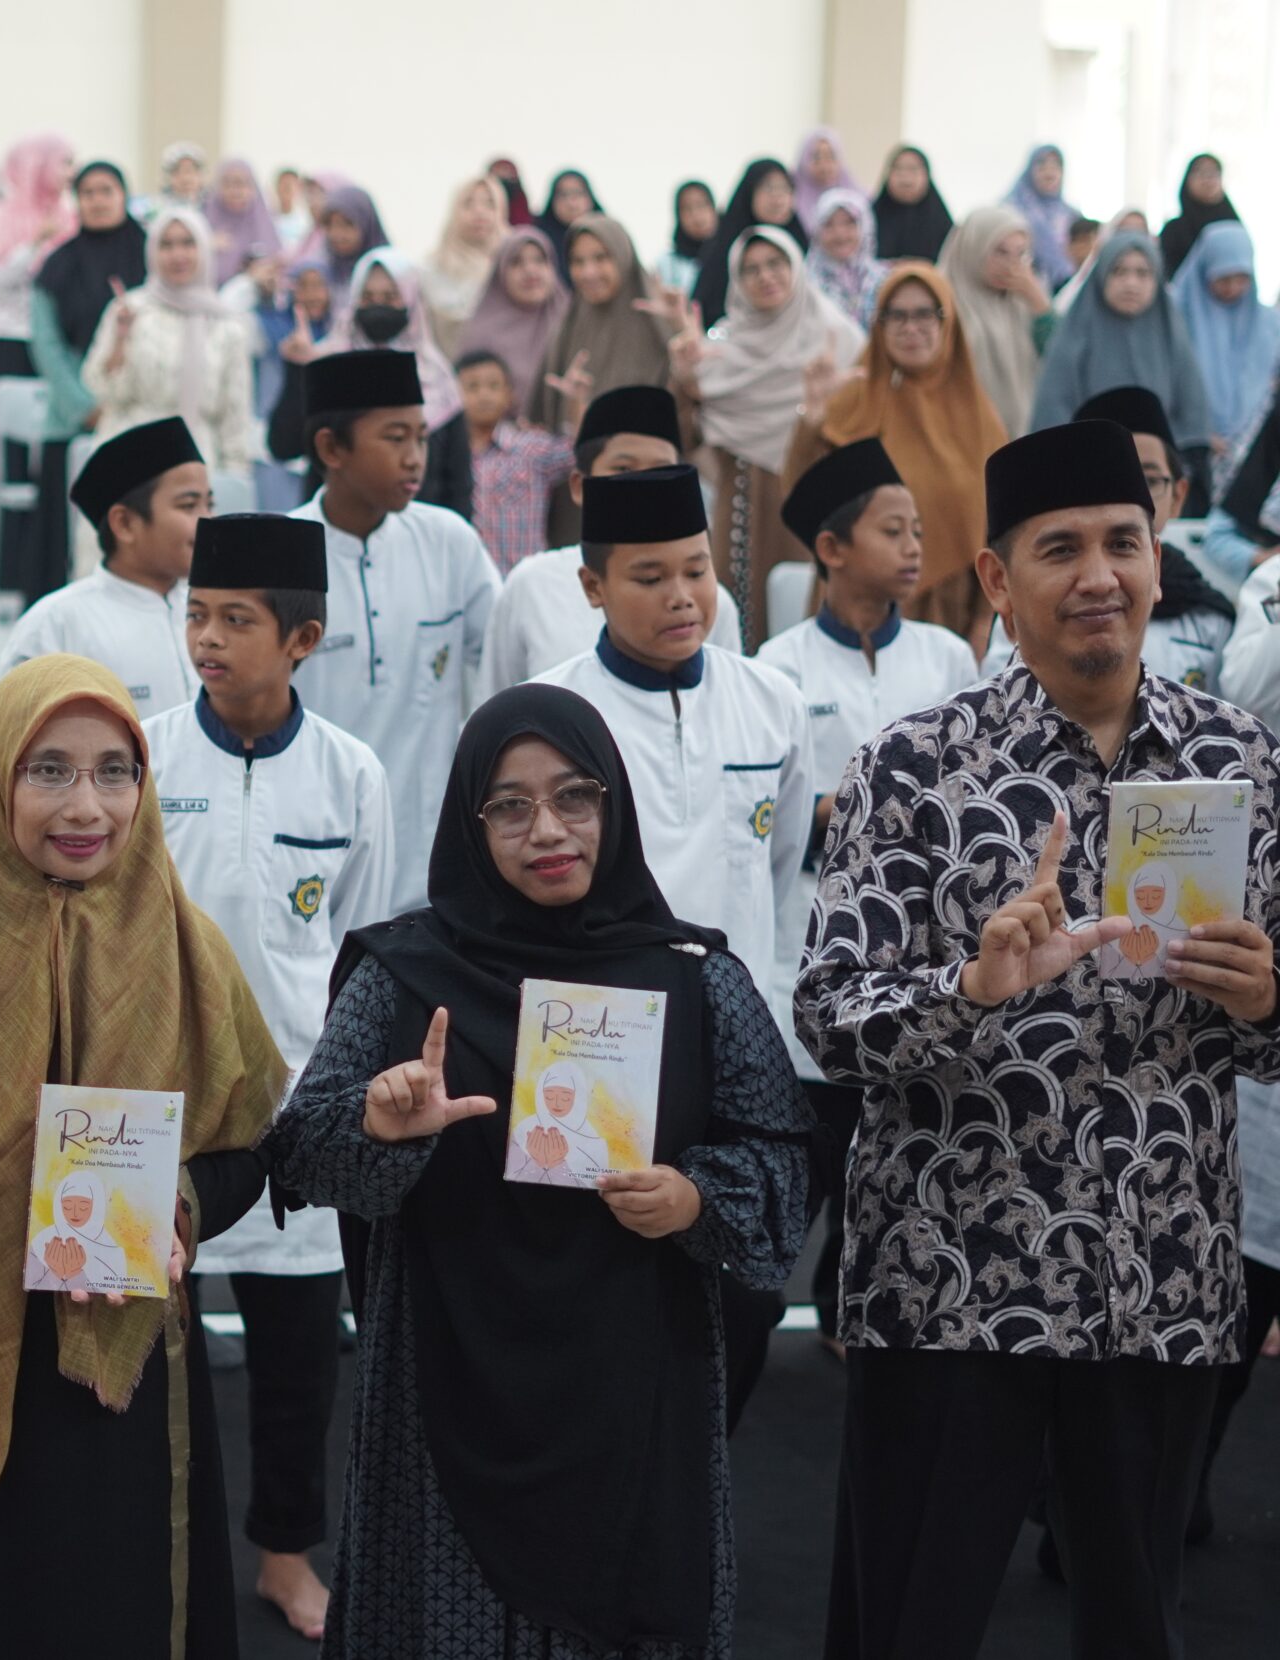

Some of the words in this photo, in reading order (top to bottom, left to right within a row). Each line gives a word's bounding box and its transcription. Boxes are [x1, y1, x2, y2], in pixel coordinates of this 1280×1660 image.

[1127, 803, 1214, 846] Rindu
[538, 1000, 625, 1042] Rindu
[621, 1022, 652, 1030] TITIPKAN
[582, 1041, 619, 1049] PADA-NYA
[55, 1109, 143, 1152] Rindu
[139, 1128, 171, 1136] TITIPKAN
[100, 1149, 137, 1157] PADA-NYA
